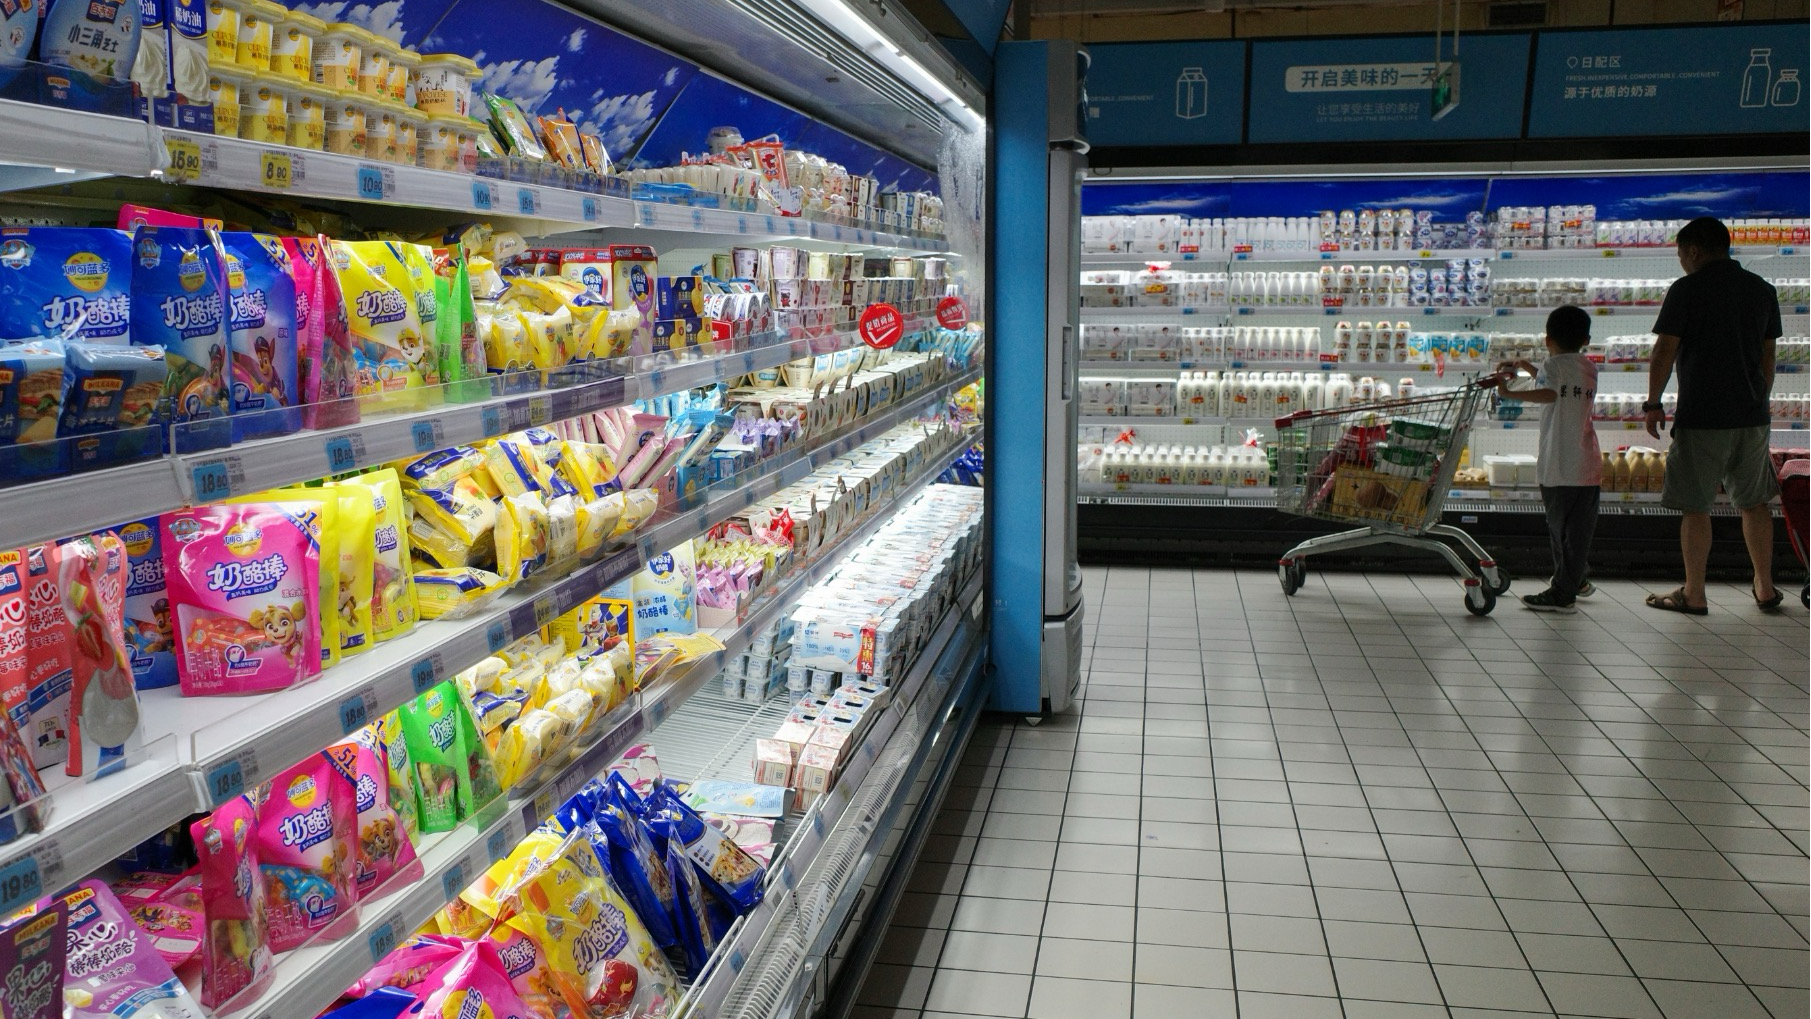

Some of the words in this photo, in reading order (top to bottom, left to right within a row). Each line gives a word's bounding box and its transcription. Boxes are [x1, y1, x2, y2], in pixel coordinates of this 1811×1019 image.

[174, 6, 202, 27] 稀奶油
[1581, 56, 1622, 69] 日配区
[1564, 85, 1658, 99] 源于优质的奶源
[1316, 102, 1421, 116] 让您享受生活的美好
[62, 261, 111, 276] 妙可蓝多
[42, 292, 131, 330] 奶酪棒
[160, 292, 222, 330] 奶酪棒
[356, 288, 407, 318] 奶酪棒
[865, 311, 895, 332] 促销商品
[206, 553, 288, 593] 奶酪棒
[637, 604, 669, 620] 奶酪棒
[572, 902, 628, 977] 奶酪棒
[69, 940, 134, 976] 棒棒奶酪
